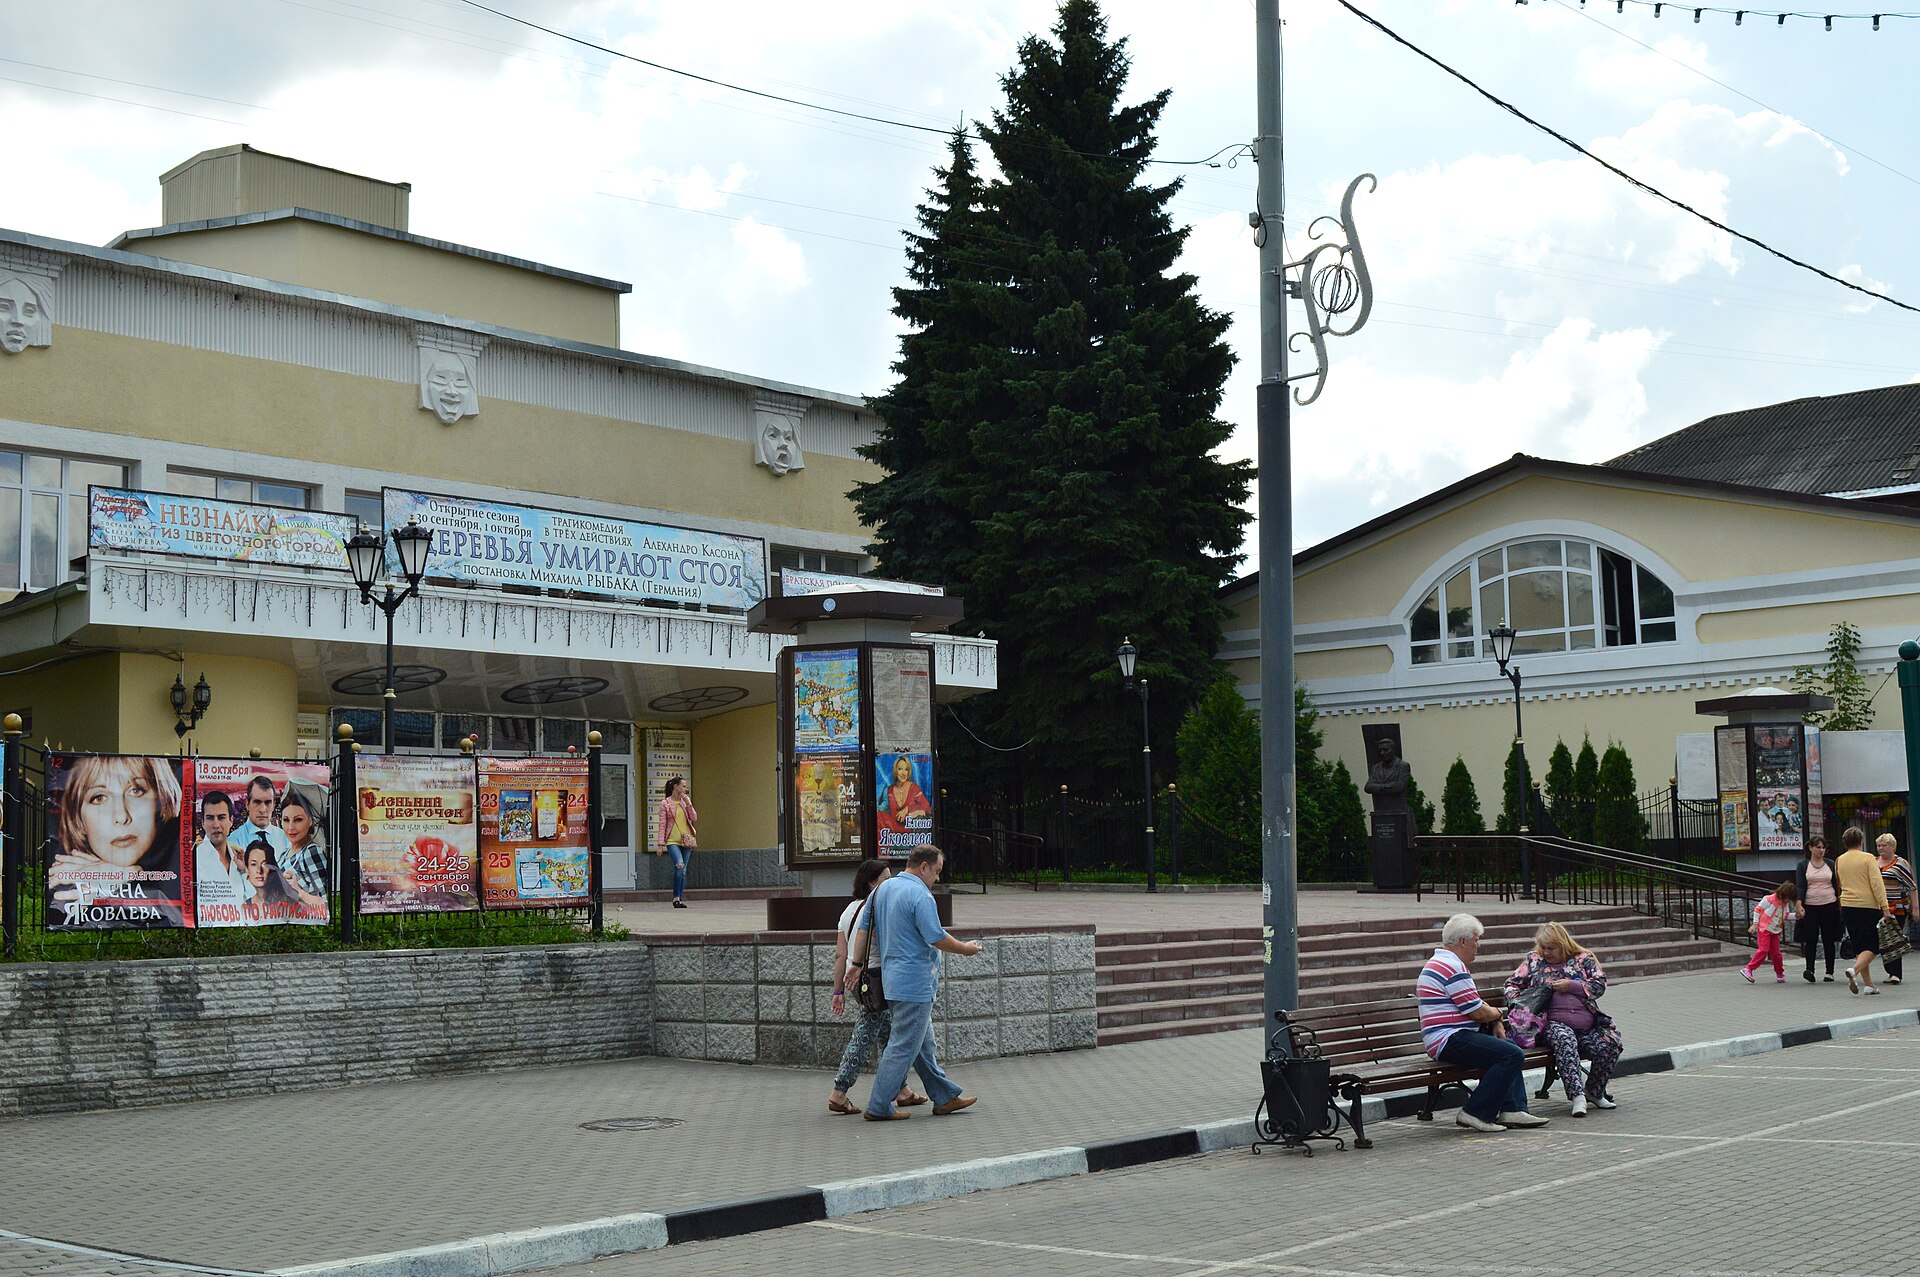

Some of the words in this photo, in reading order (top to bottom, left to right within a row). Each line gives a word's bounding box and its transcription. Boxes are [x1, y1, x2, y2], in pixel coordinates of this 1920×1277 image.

[160, 503, 279, 536] НЕЗНАЙКА
[428, 499, 484, 519] Открытие
[486, 510, 521, 525] сезона
[416, 513, 428, 525] 30
[430, 515, 482, 533] сентября,
[484, 522, 489, 532] 1
[490, 523, 533, 539] октября
[552, 516, 624, 535] ТРАГИКОМЕДИЯ
[160, 527, 180, 539] ИЗ
[185, 529, 282, 550] ЦВЕТОЧНОГО
[286, 541, 341, 555] ГОРОДА
[544, 527, 550, 537] В
[580, 531, 633, 548] ДЕЙСТВИЯХ
[540, 541, 672, 581] УМИРАЮТ
[679, 558, 743, 589] СТОЯ
[463, 564, 527, 580] ПОСТАНОВКА
[586, 573, 639, 592] РЫБАКА
[50, 757, 64, 769] 12
[198, 762, 209, 774] 18
[211, 764, 249, 777] октября
[481, 792, 498, 808] 23
[837, 783, 855, 799] 24
[567, 793, 587, 808] 24
[416, 855, 470, 872] 24-25
[488, 852, 512, 869] 25
[416, 873, 470, 883] сентября
[419, 885, 427, 893] в
[432, 883, 470, 893] 11.00
[485, 888, 517, 900] 18.30
[64, 902, 161, 926] ЯКОВЛЕВА
[200, 903, 240, 922] ЛЮБОВЬ
[242, 903, 260, 921] ПО
[262, 901, 327, 921] РАСПИСАНИЮ
